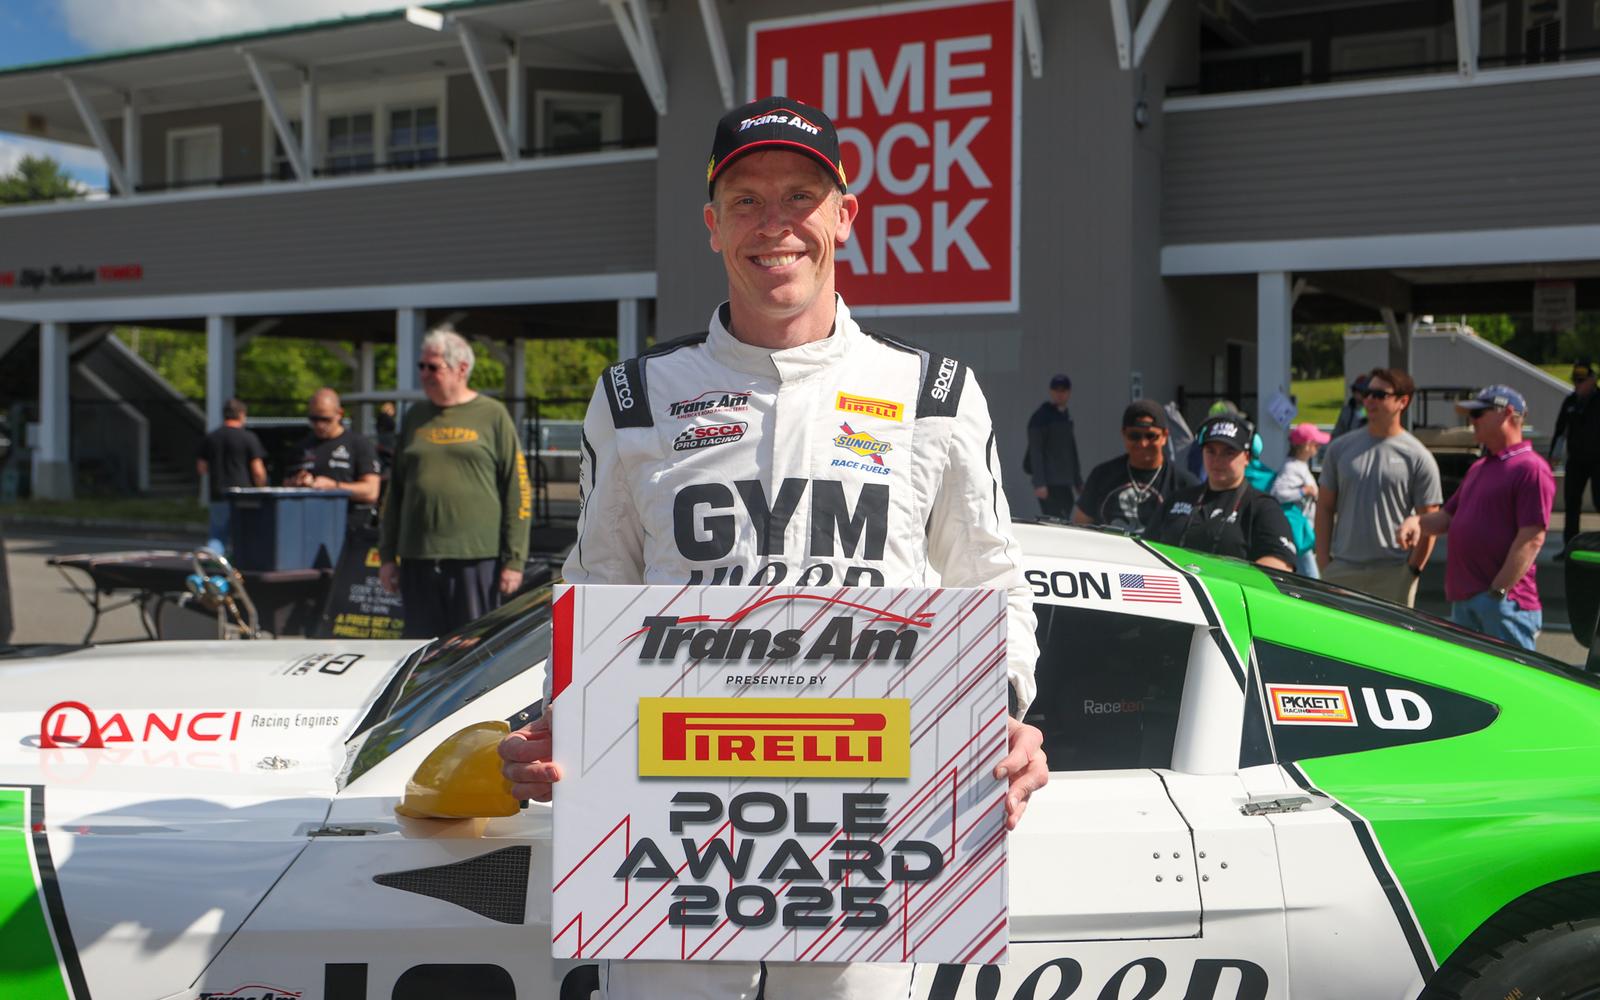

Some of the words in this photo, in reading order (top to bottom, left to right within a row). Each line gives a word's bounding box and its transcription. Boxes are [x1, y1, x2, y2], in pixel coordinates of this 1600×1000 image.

[738, 113, 788, 133] Trans
[788, 116, 819, 135] Am
[836, 117, 993, 196] OCK
[835, 199, 991, 275] ARK
[670, 399, 716, 417] Trans
[716, 394, 749, 408] Am
[838, 396, 898, 418] PIRELLI
[676, 440, 699, 450] PRO
[700, 434, 740, 447] RACING
[694, 424, 745, 438] SCCA
[837, 435, 888, 454] SUNOCO
[831, 459, 860, 470] RACE
[860, 463, 891, 476] FUELS
[673, 478, 890, 562] GYM
[1024, 570, 1112, 600] SON
[638, 615, 802, 661] Trans
[803, 615, 919, 661] Am
[726, 675, 806, 686] PRESENTED
[809, 675, 828, 686] BY
[1281, 696, 1340, 710] PICKETT
[40, 701, 242, 749] LANCI
[251, 714, 291, 729] Racing
[295, 713, 339, 728] Engines
[662, 711, 887, 763] PIRELLI
[669, 791, 890, 834] POLE
[612, 836, 945, 883] AWARD
[668, 884, 890, 928] 2025
